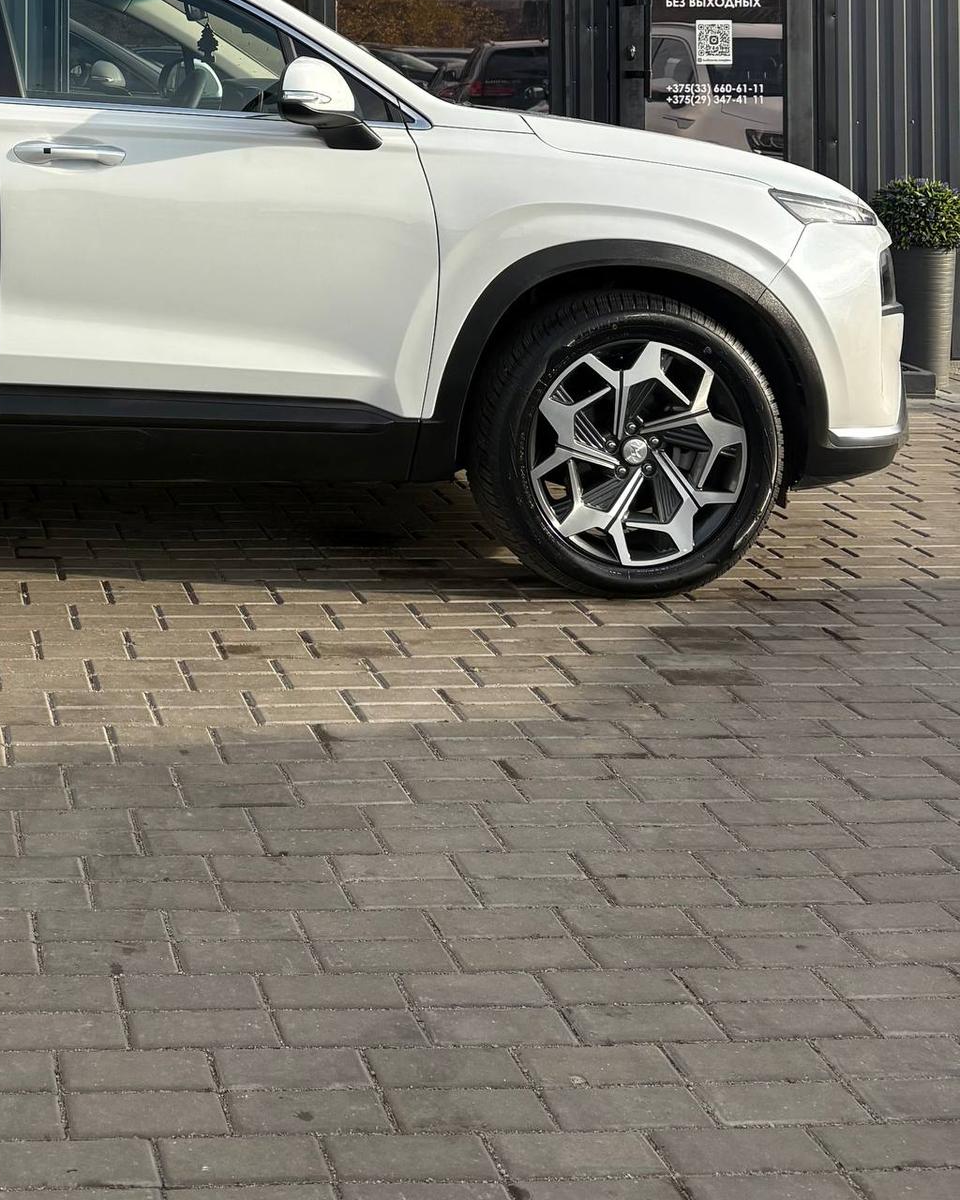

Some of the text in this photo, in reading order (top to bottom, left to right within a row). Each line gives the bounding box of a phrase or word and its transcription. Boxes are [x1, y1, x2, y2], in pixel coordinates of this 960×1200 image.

[666, 83, 764, 96] +375(33) 660-61-11
[666, 95, 764, 106] +375(29) 347-4111
